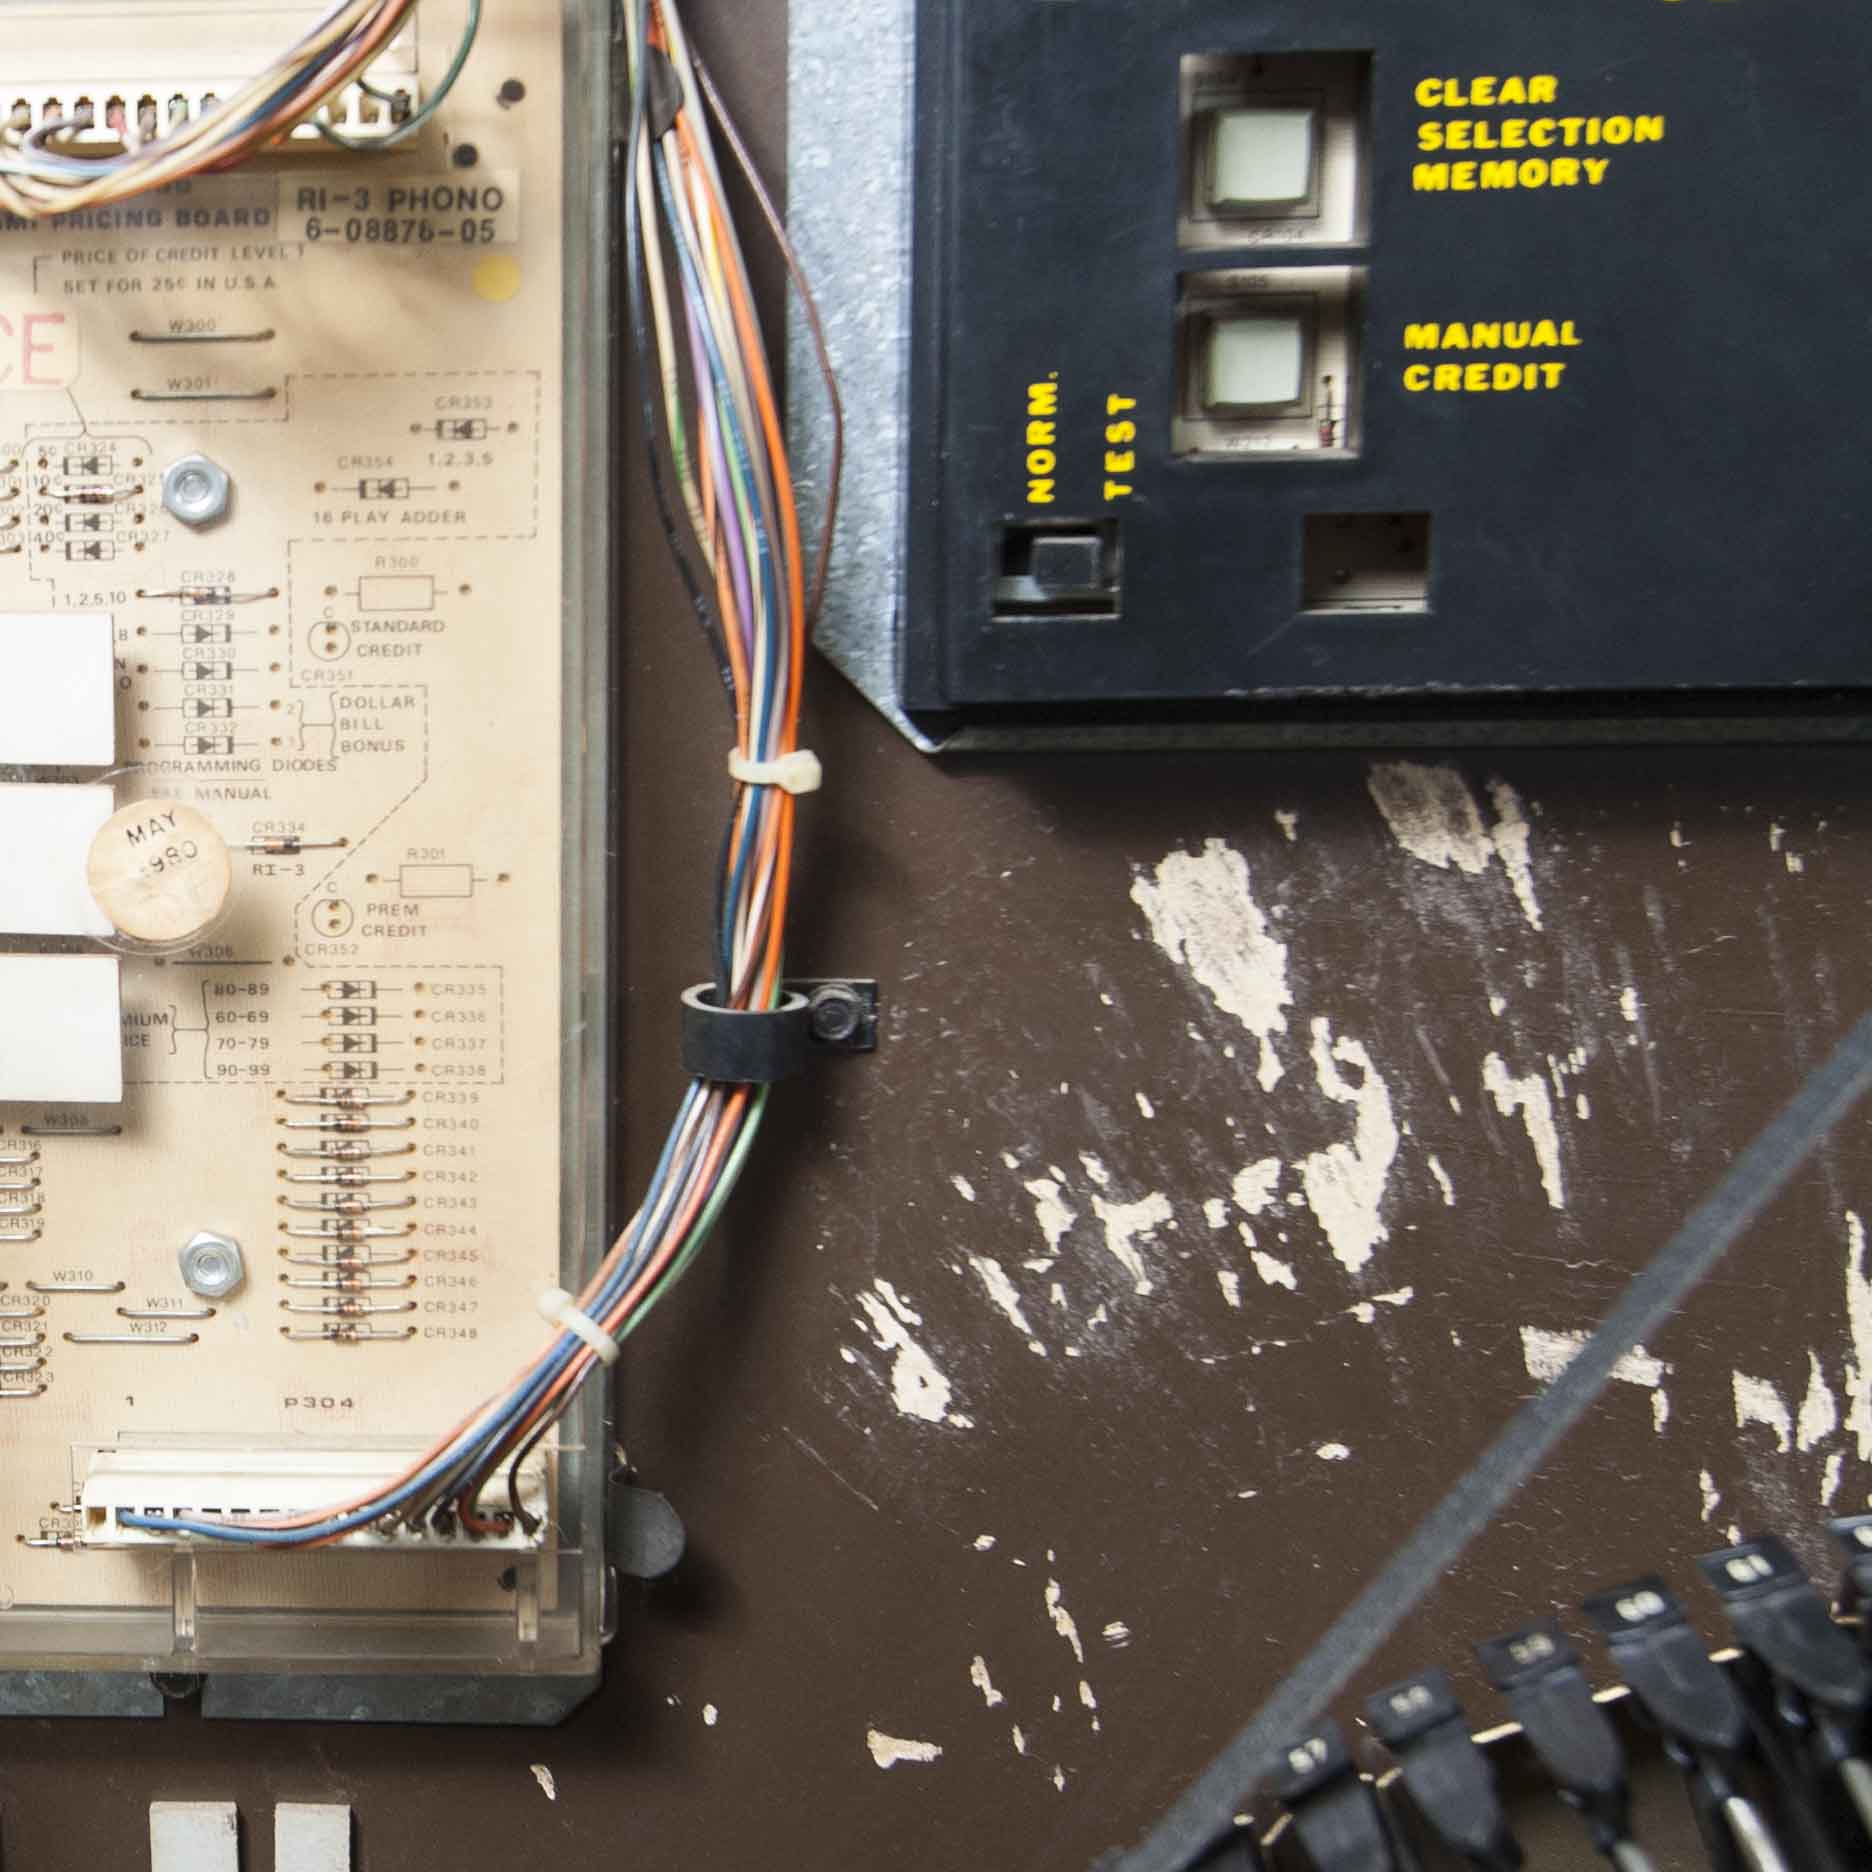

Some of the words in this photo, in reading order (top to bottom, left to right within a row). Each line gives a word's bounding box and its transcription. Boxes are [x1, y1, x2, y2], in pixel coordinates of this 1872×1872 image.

[1414, 75, 1558, 108] CLEAR
[1417, 115, 1665, 152] SELECTION
[1412, 157, 1610, 191] MEMORY
[297, 188, 369, 212] RI-3
[388, 186, 503, 212] PHONO
[52, 209, 164, 231] PRICING
[176, 208, 271, 227] BOARD
[62, 249, 118, 265] PRICE
[128, 248, 148, 262] OF
[156, 247, 219, 262] CREDIT
[231, 246, 289, 260] LEVEL
[63, 279, 98, 295] SET
[105, 278, 142, 293] FOR
[197, 276, 215, 290] IN
[1403, 319, 1583, 350] MANUAL
[1402, 362, 1566, 392] CREDIT
[1026, 371, 1058, 503] NORM.
[1104, 393, 1136, 501] TEST
[342, 511, 389, 524] PLAY
[401, 511, 466, 524] ADDER
[351, 619, 445, 634] STANDARD
[357, 644, 423, 657] CREDIT
[339, 696, 416, 710] DOLLAR
[339, 717, 383, 731] BILL
[341, 739, 405, 753] BONUS
[272, 759, 337, 772] DIODES
[196, 787, 272, 800] MANUAL
[125, 809, 176, 848] MAY
[140, 840, 198, 873] 980
[367, 904, 419, 917] PREM
[361, 925, 427, 938] CREDIT
[214, 983, 270, 996] 80-89
[216, 1011, 270, 1023] 60-69
[216, 1037, 270, 1050] 70-79
[217, 1064, 271, 1077] 90-99
[53, 1270, 93, 1281] W310
[147, 1297, 184, 1308] W311
[130, 1322, 167, 1333] W312
[284, 1397, 354, 1409] P304
